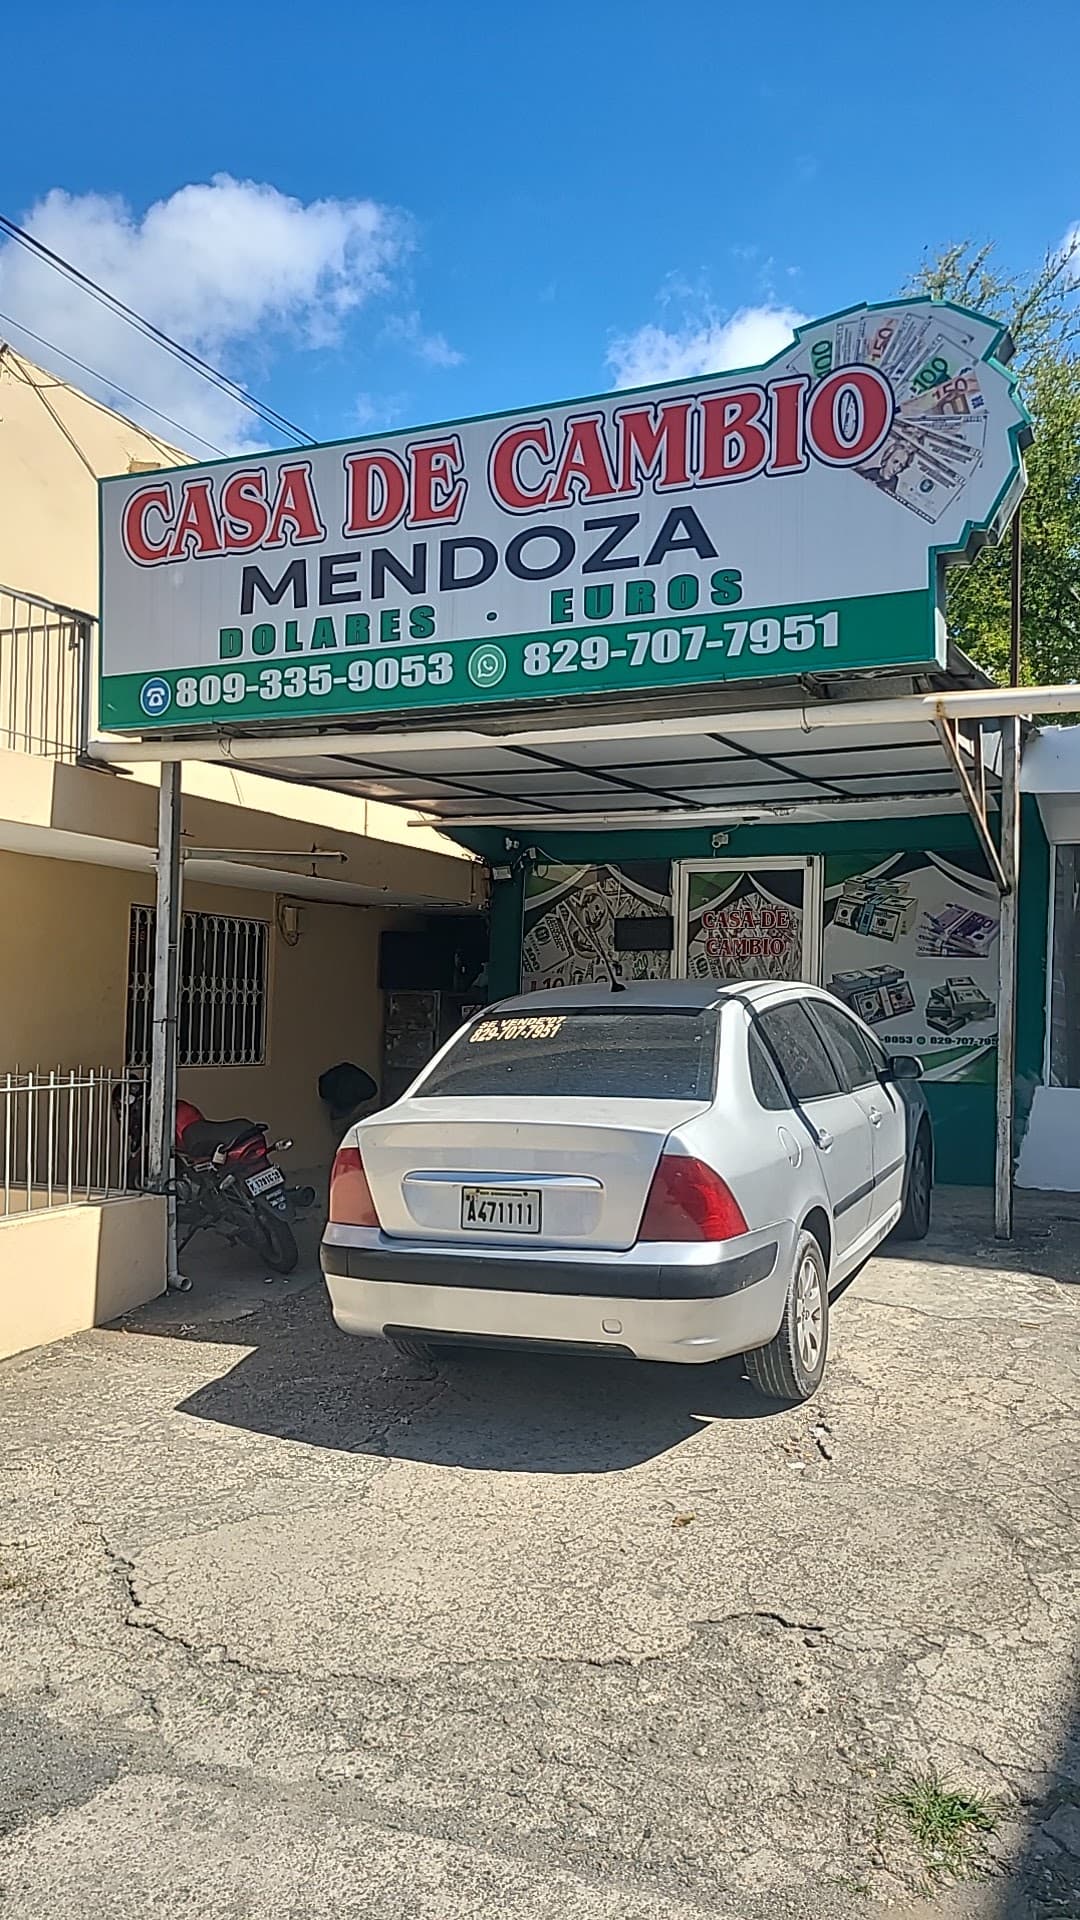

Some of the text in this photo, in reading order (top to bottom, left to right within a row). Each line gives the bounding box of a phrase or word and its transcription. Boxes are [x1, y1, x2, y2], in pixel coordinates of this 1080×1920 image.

[122, 364, 896, 567] CASA DE CAMBIO
[240, 506, 719, 616] MENDOZA
[219, 568, 743, 660] DOLARES EUROS
[176, 611, 839, 708] 809-335-9053 829-707-7951
[702, 909, 790, 930] CASA DE
[706, 935, 786, 958] CAMBIO
[479, 1020, 498, 1029] SE
[467, 1199, 532, 1225] A471111
